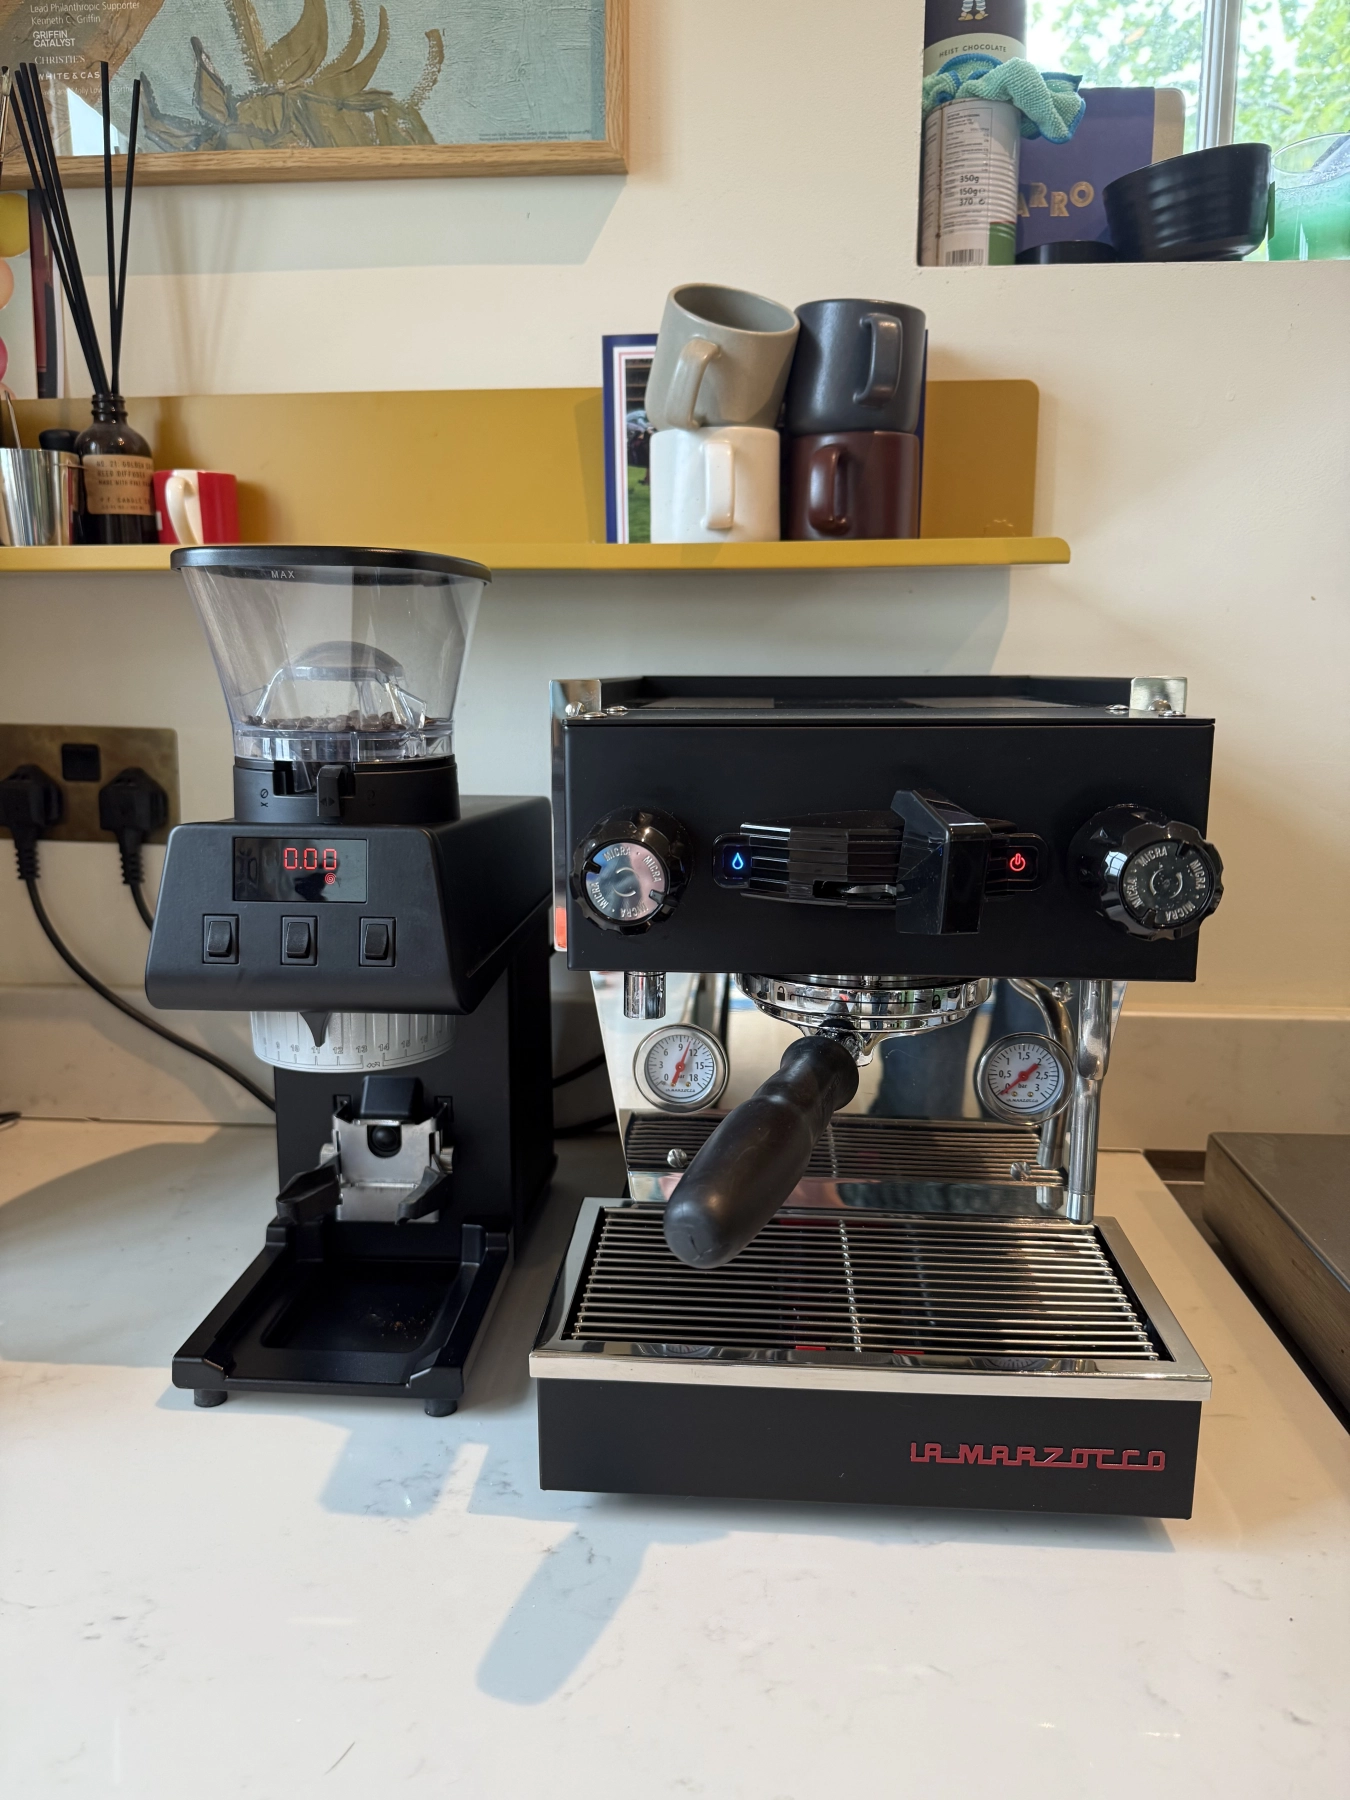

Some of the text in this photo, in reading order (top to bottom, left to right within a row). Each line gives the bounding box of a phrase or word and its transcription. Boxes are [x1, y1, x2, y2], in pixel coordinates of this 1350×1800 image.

[30, 2, 140, 12] Lead Philanthropic Supporter
[32, 16, 63, 25] Kenneth
[76, 15, 100, 23] Griffin
[32, 30, 68, 39] GRIFFIN
[33, 38, 75, 47] CATALYST
[939, 44, 1007, 58] HEIST CHOCOLATE
[39, 72, 70, 80] WHITE
[960, 175, 979, 183] 350g
[960, 188, 978, 196] 150g
[271, 570, 295, 579] MAX
[603, 846, 631, 862] MICRA
[284, 848, 337, 870] 0.00
[643, 855, 662, 883] MICRA
[1126, 846, 1206, 922] MICRA MICRA MICRA MICRA
[590, 881, 609, 910] MICRA
[378, 1043, 389, 1051] 14
[1018, 1052, 1030, 1060] 1,5
[999, 1070, 1011, 1078] 0,5
[1036, 1072, 1048, 1080] 2,5
[910, 1443, 1165, 1471] LA MARZOCCO
